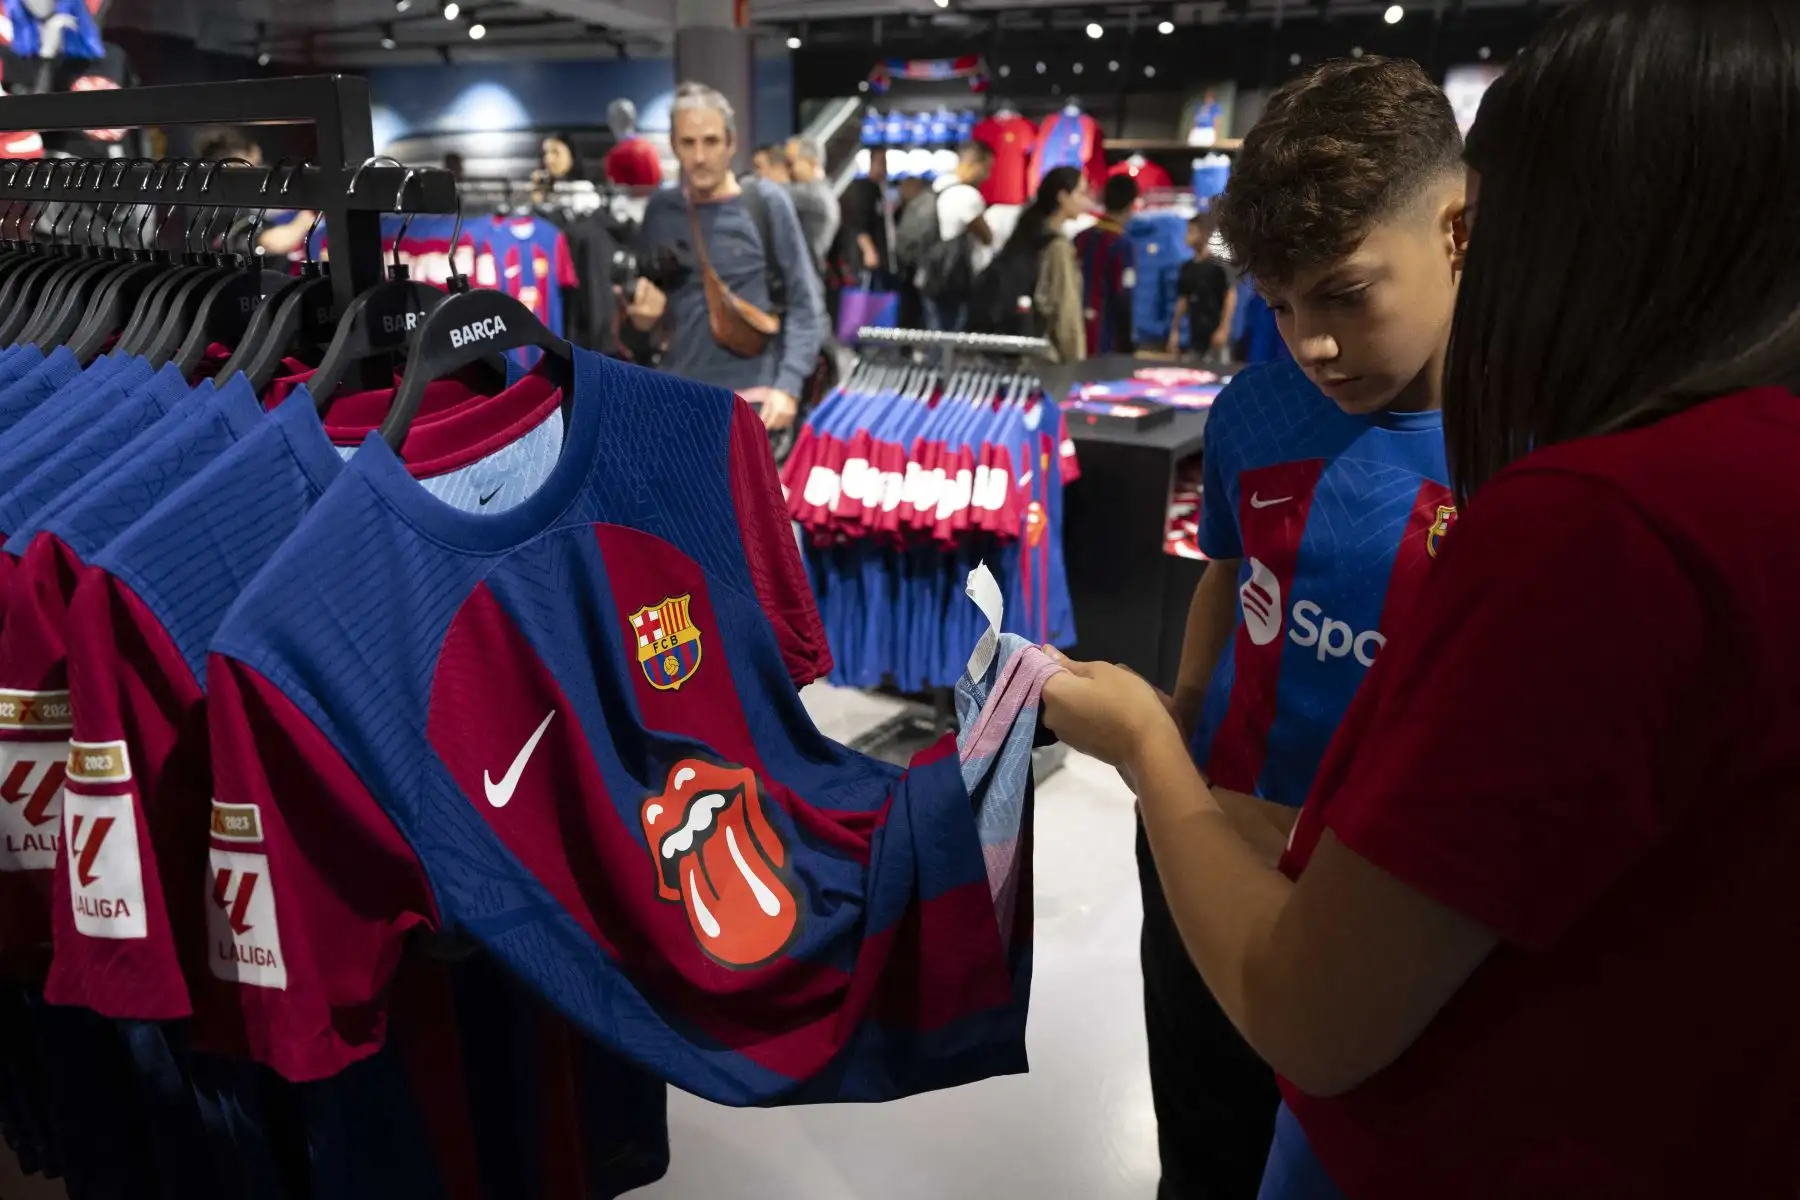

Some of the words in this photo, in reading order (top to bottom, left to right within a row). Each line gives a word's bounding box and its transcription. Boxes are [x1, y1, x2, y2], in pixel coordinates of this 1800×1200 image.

[449, 315, 507, 348] BARÇA
[652, 634, 679, 654] FCB
[84, 755, 114, 771] 2023
[224, 815, 250, 831] 2023
[6, 833, 60, 852] LALI
[218, 940, 277, 969] LALIGA
